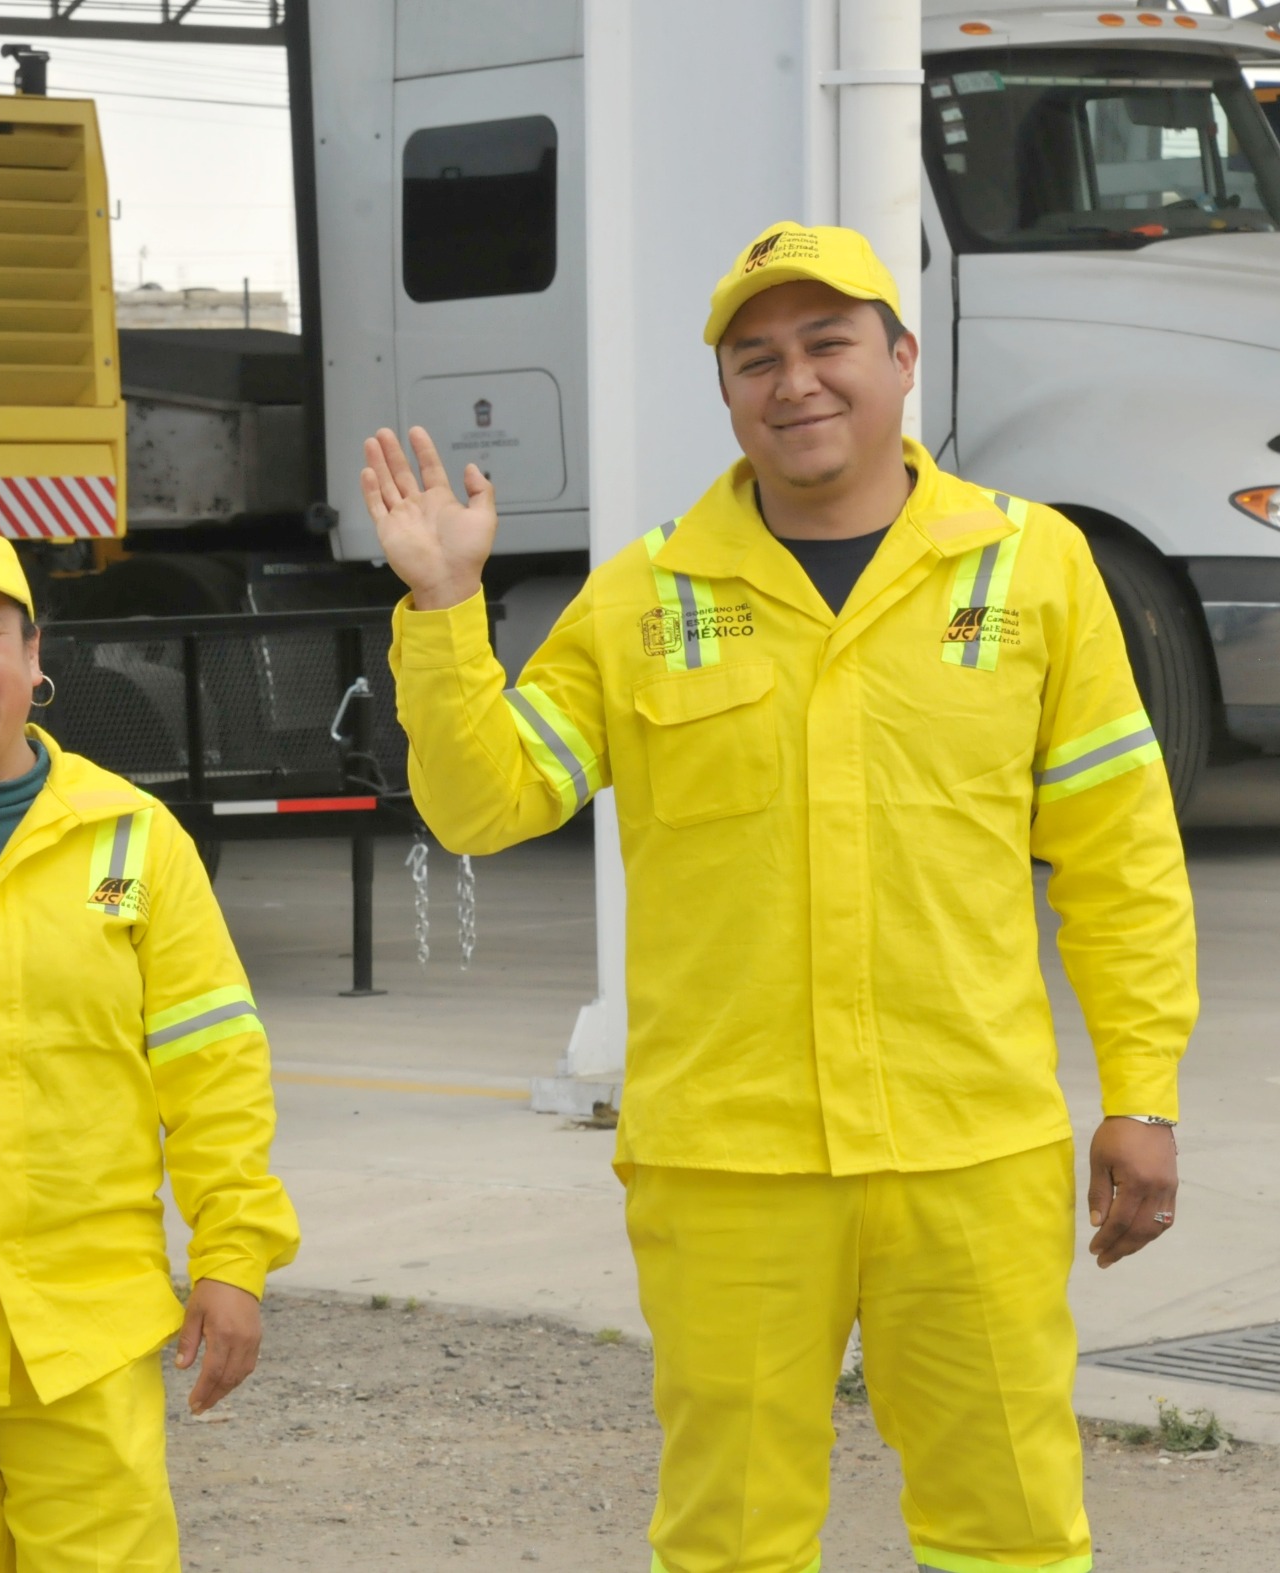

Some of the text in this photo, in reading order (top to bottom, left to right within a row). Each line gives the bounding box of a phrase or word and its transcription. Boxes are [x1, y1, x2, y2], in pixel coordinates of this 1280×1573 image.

[686, 603, 751, 617] GOBIERNO DEL
[686, 612, 752, 627] ESTADO DE
[687, 625, 754, 641] MÉXICO
[948, 628, 974, 640] JC
[94, 894, 120, 903] JC
